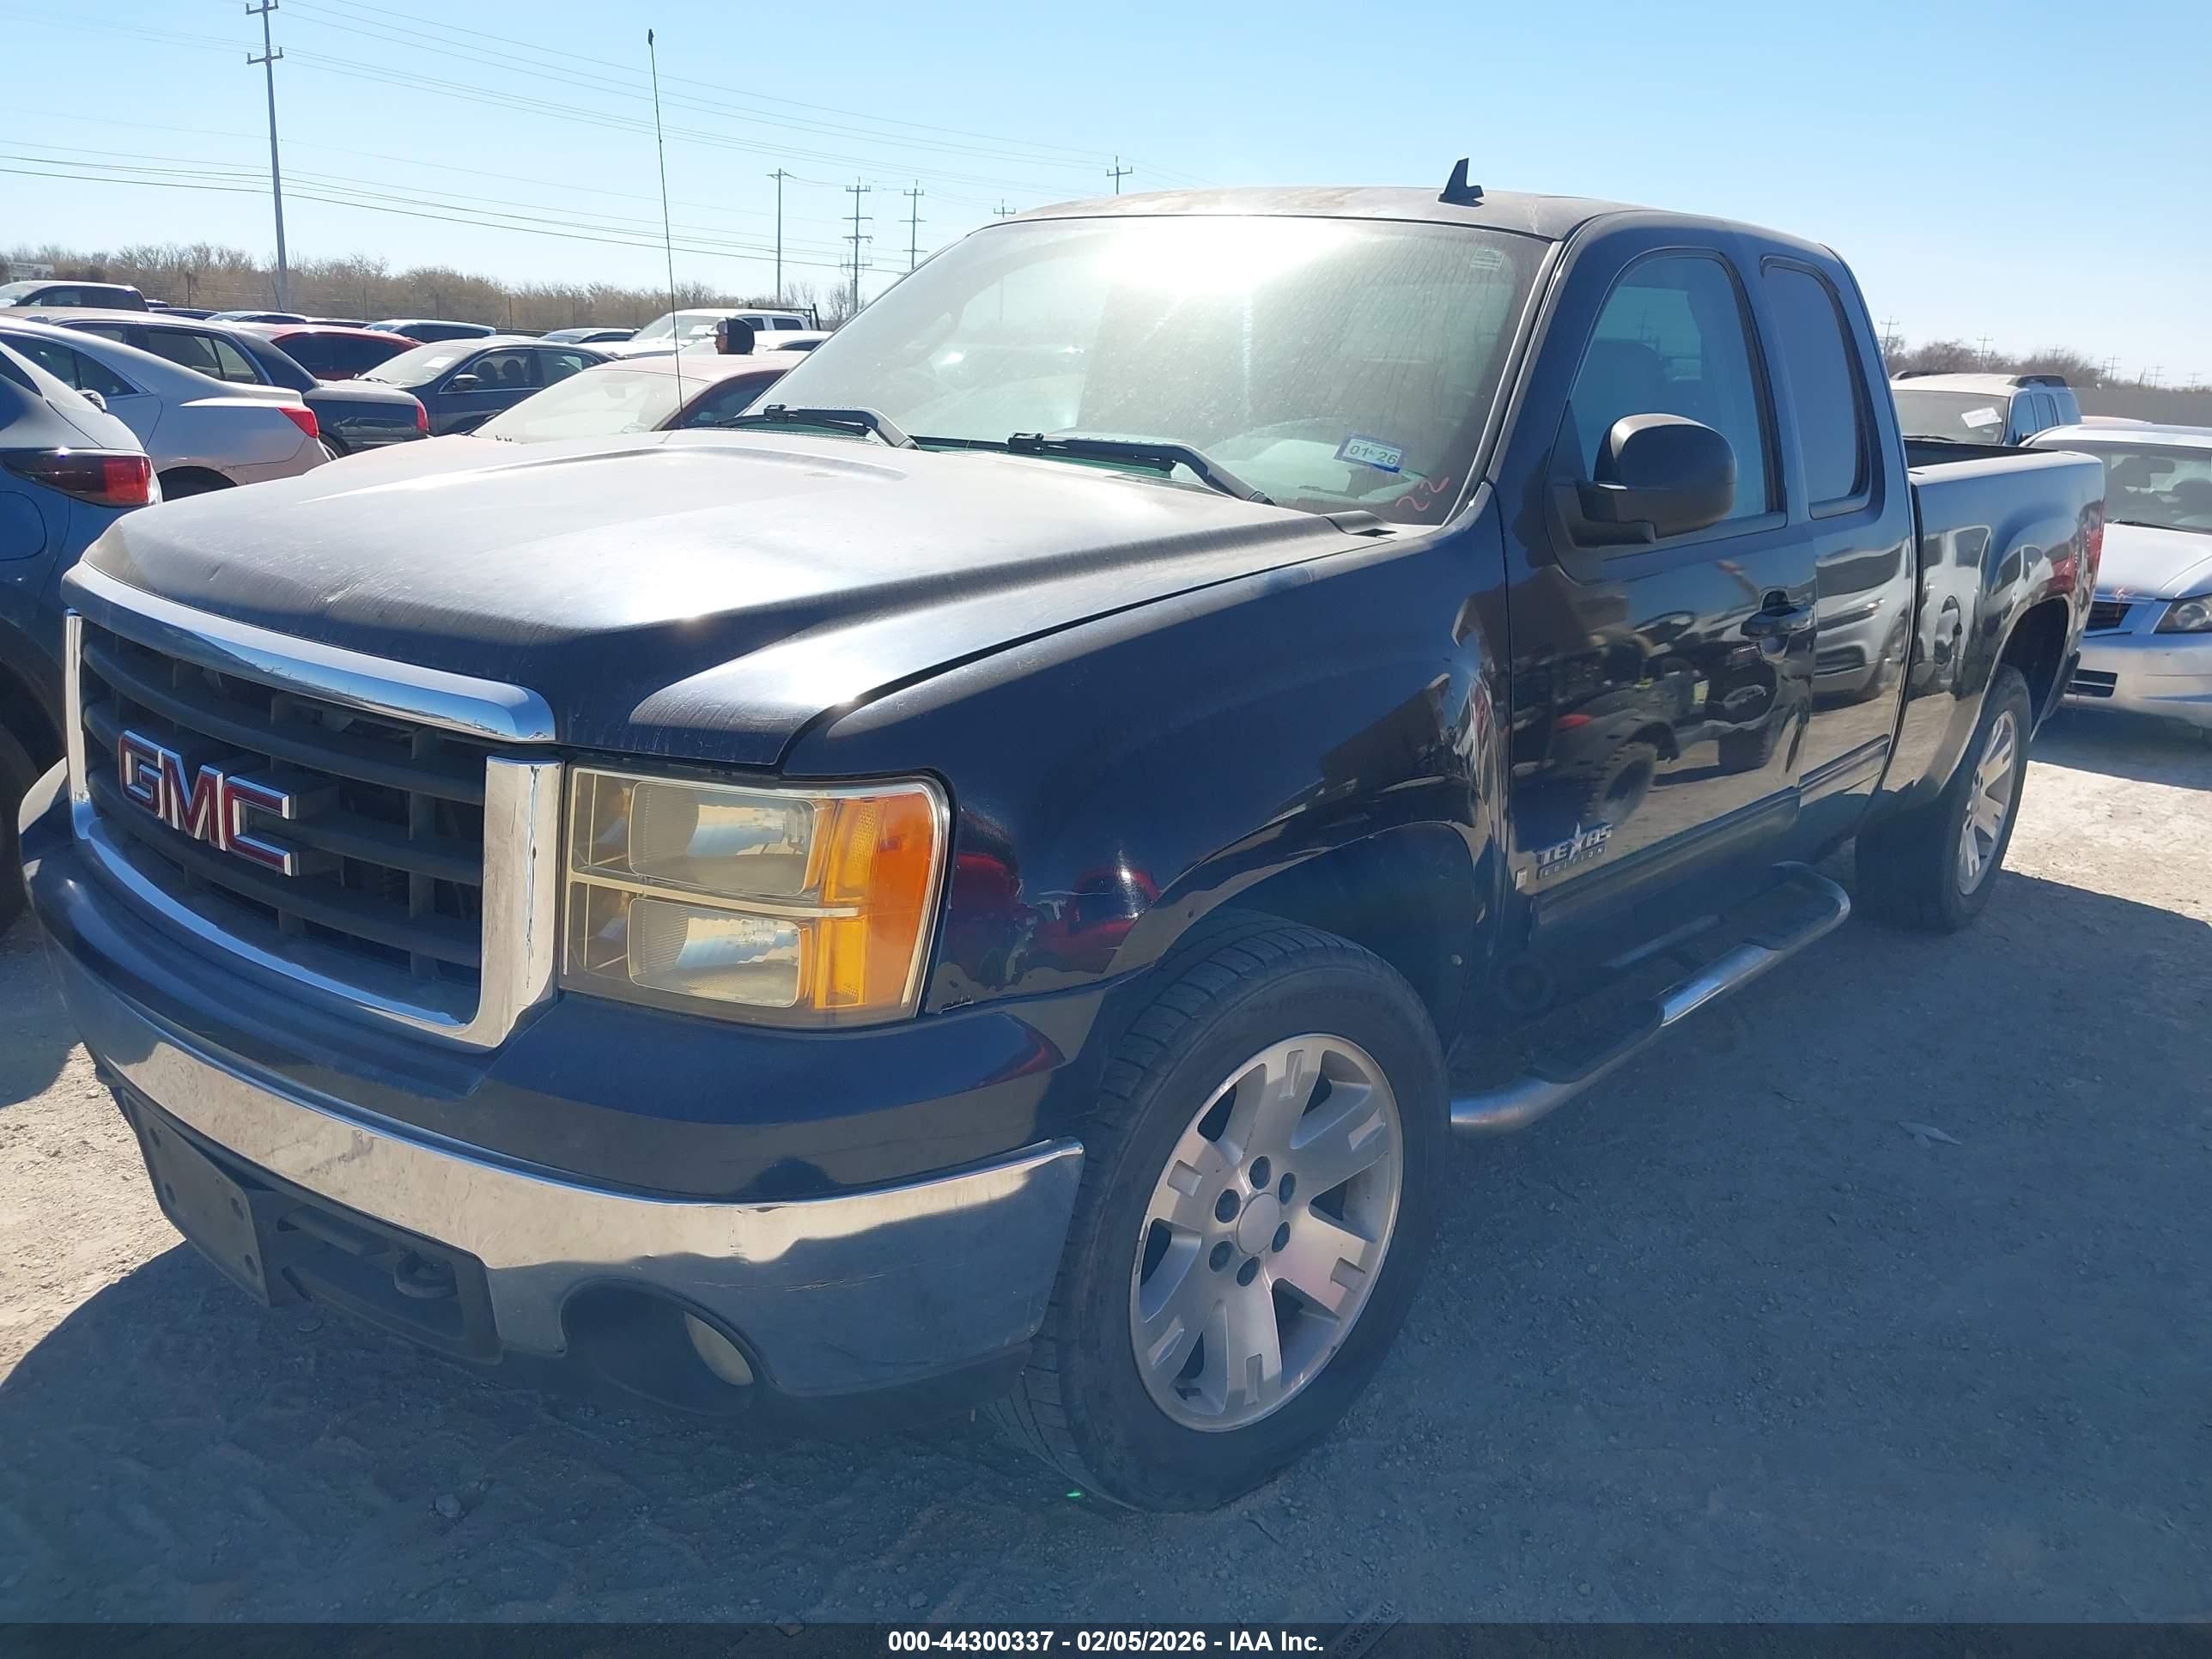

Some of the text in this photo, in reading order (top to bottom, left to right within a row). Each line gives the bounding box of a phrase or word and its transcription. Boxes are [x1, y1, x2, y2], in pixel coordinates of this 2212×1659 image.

[1375, 451, 1399, 465] 26
[118, 729, 298, 877] GMC
[1538, 823, 1613, 865] TEXAS
[1543, 847, 1604, 876] EDITION
